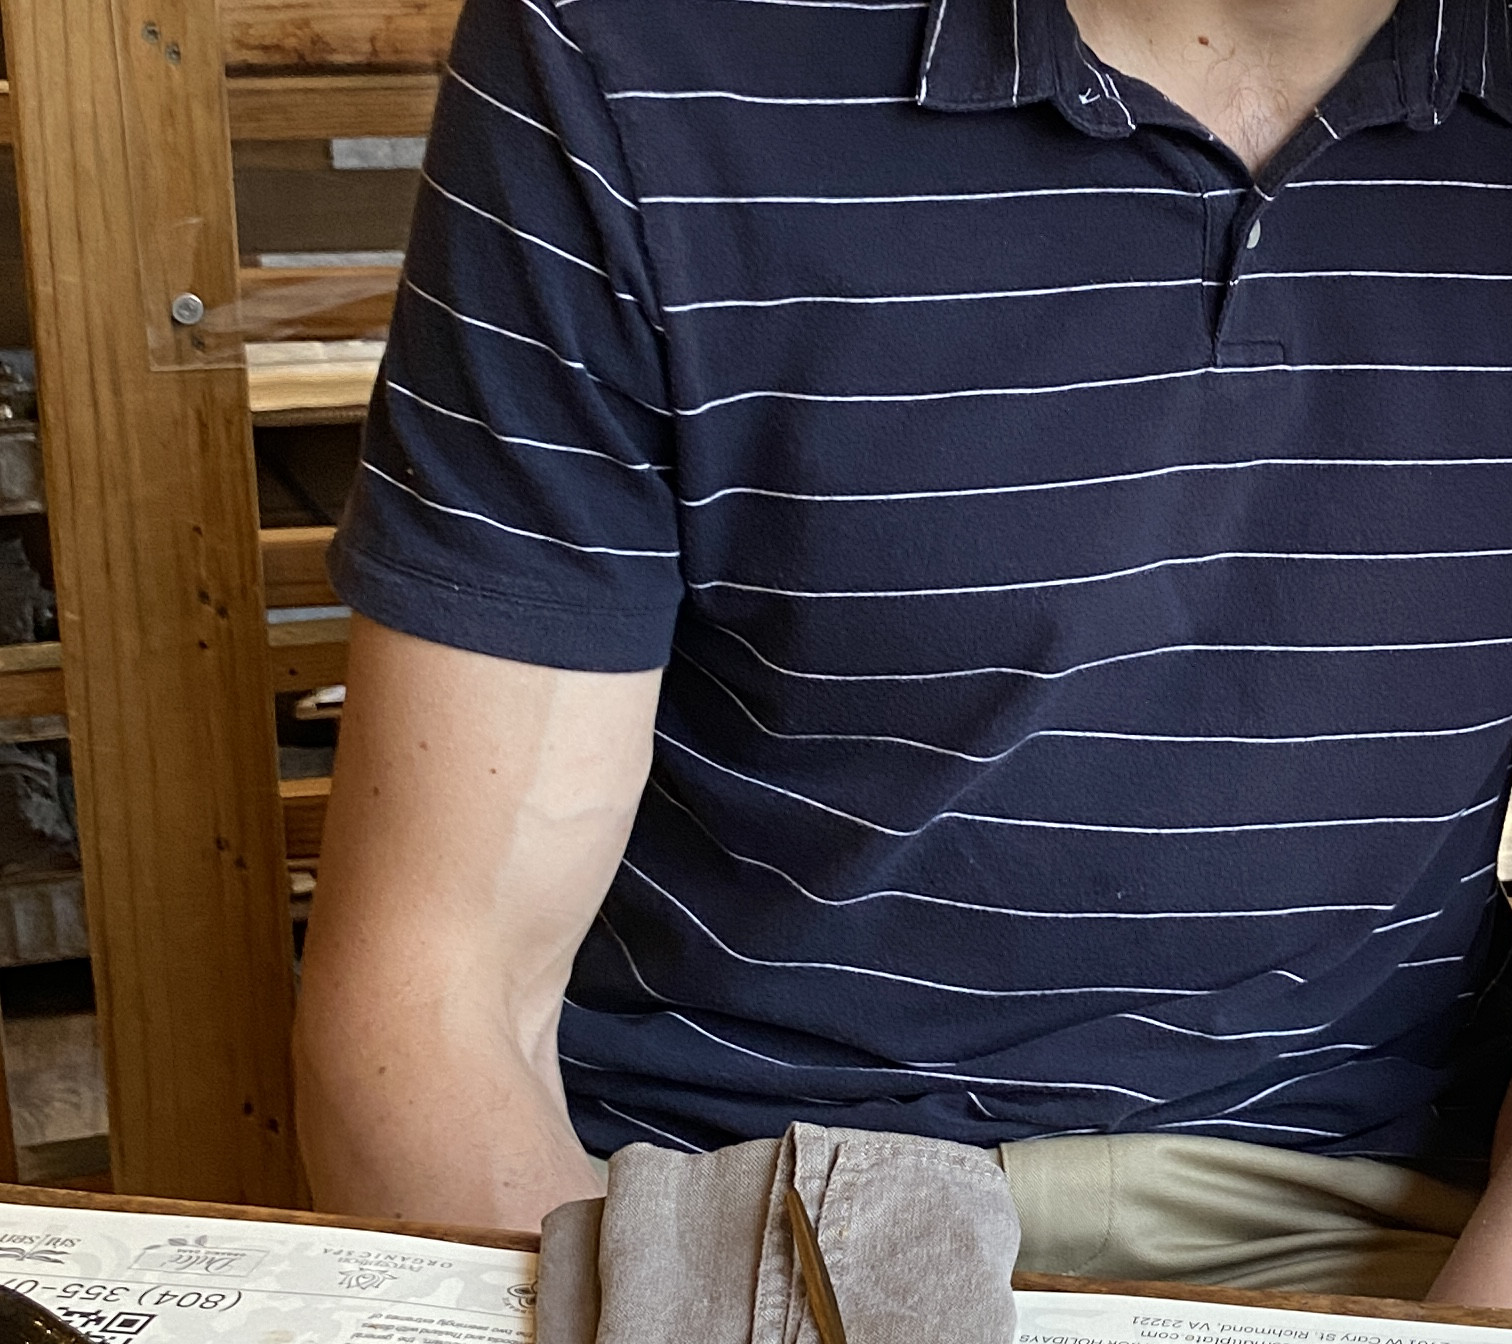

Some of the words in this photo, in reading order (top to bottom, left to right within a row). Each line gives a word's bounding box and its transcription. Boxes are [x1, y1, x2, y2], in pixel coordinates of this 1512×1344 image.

[135, 1283, 242, 1312] (804)
[1131, 1314, 1185, 1330] 23221
[1187, 1319, 1211, 1333] VA
[1216, 1321, 1310, 1340] Richmond,
